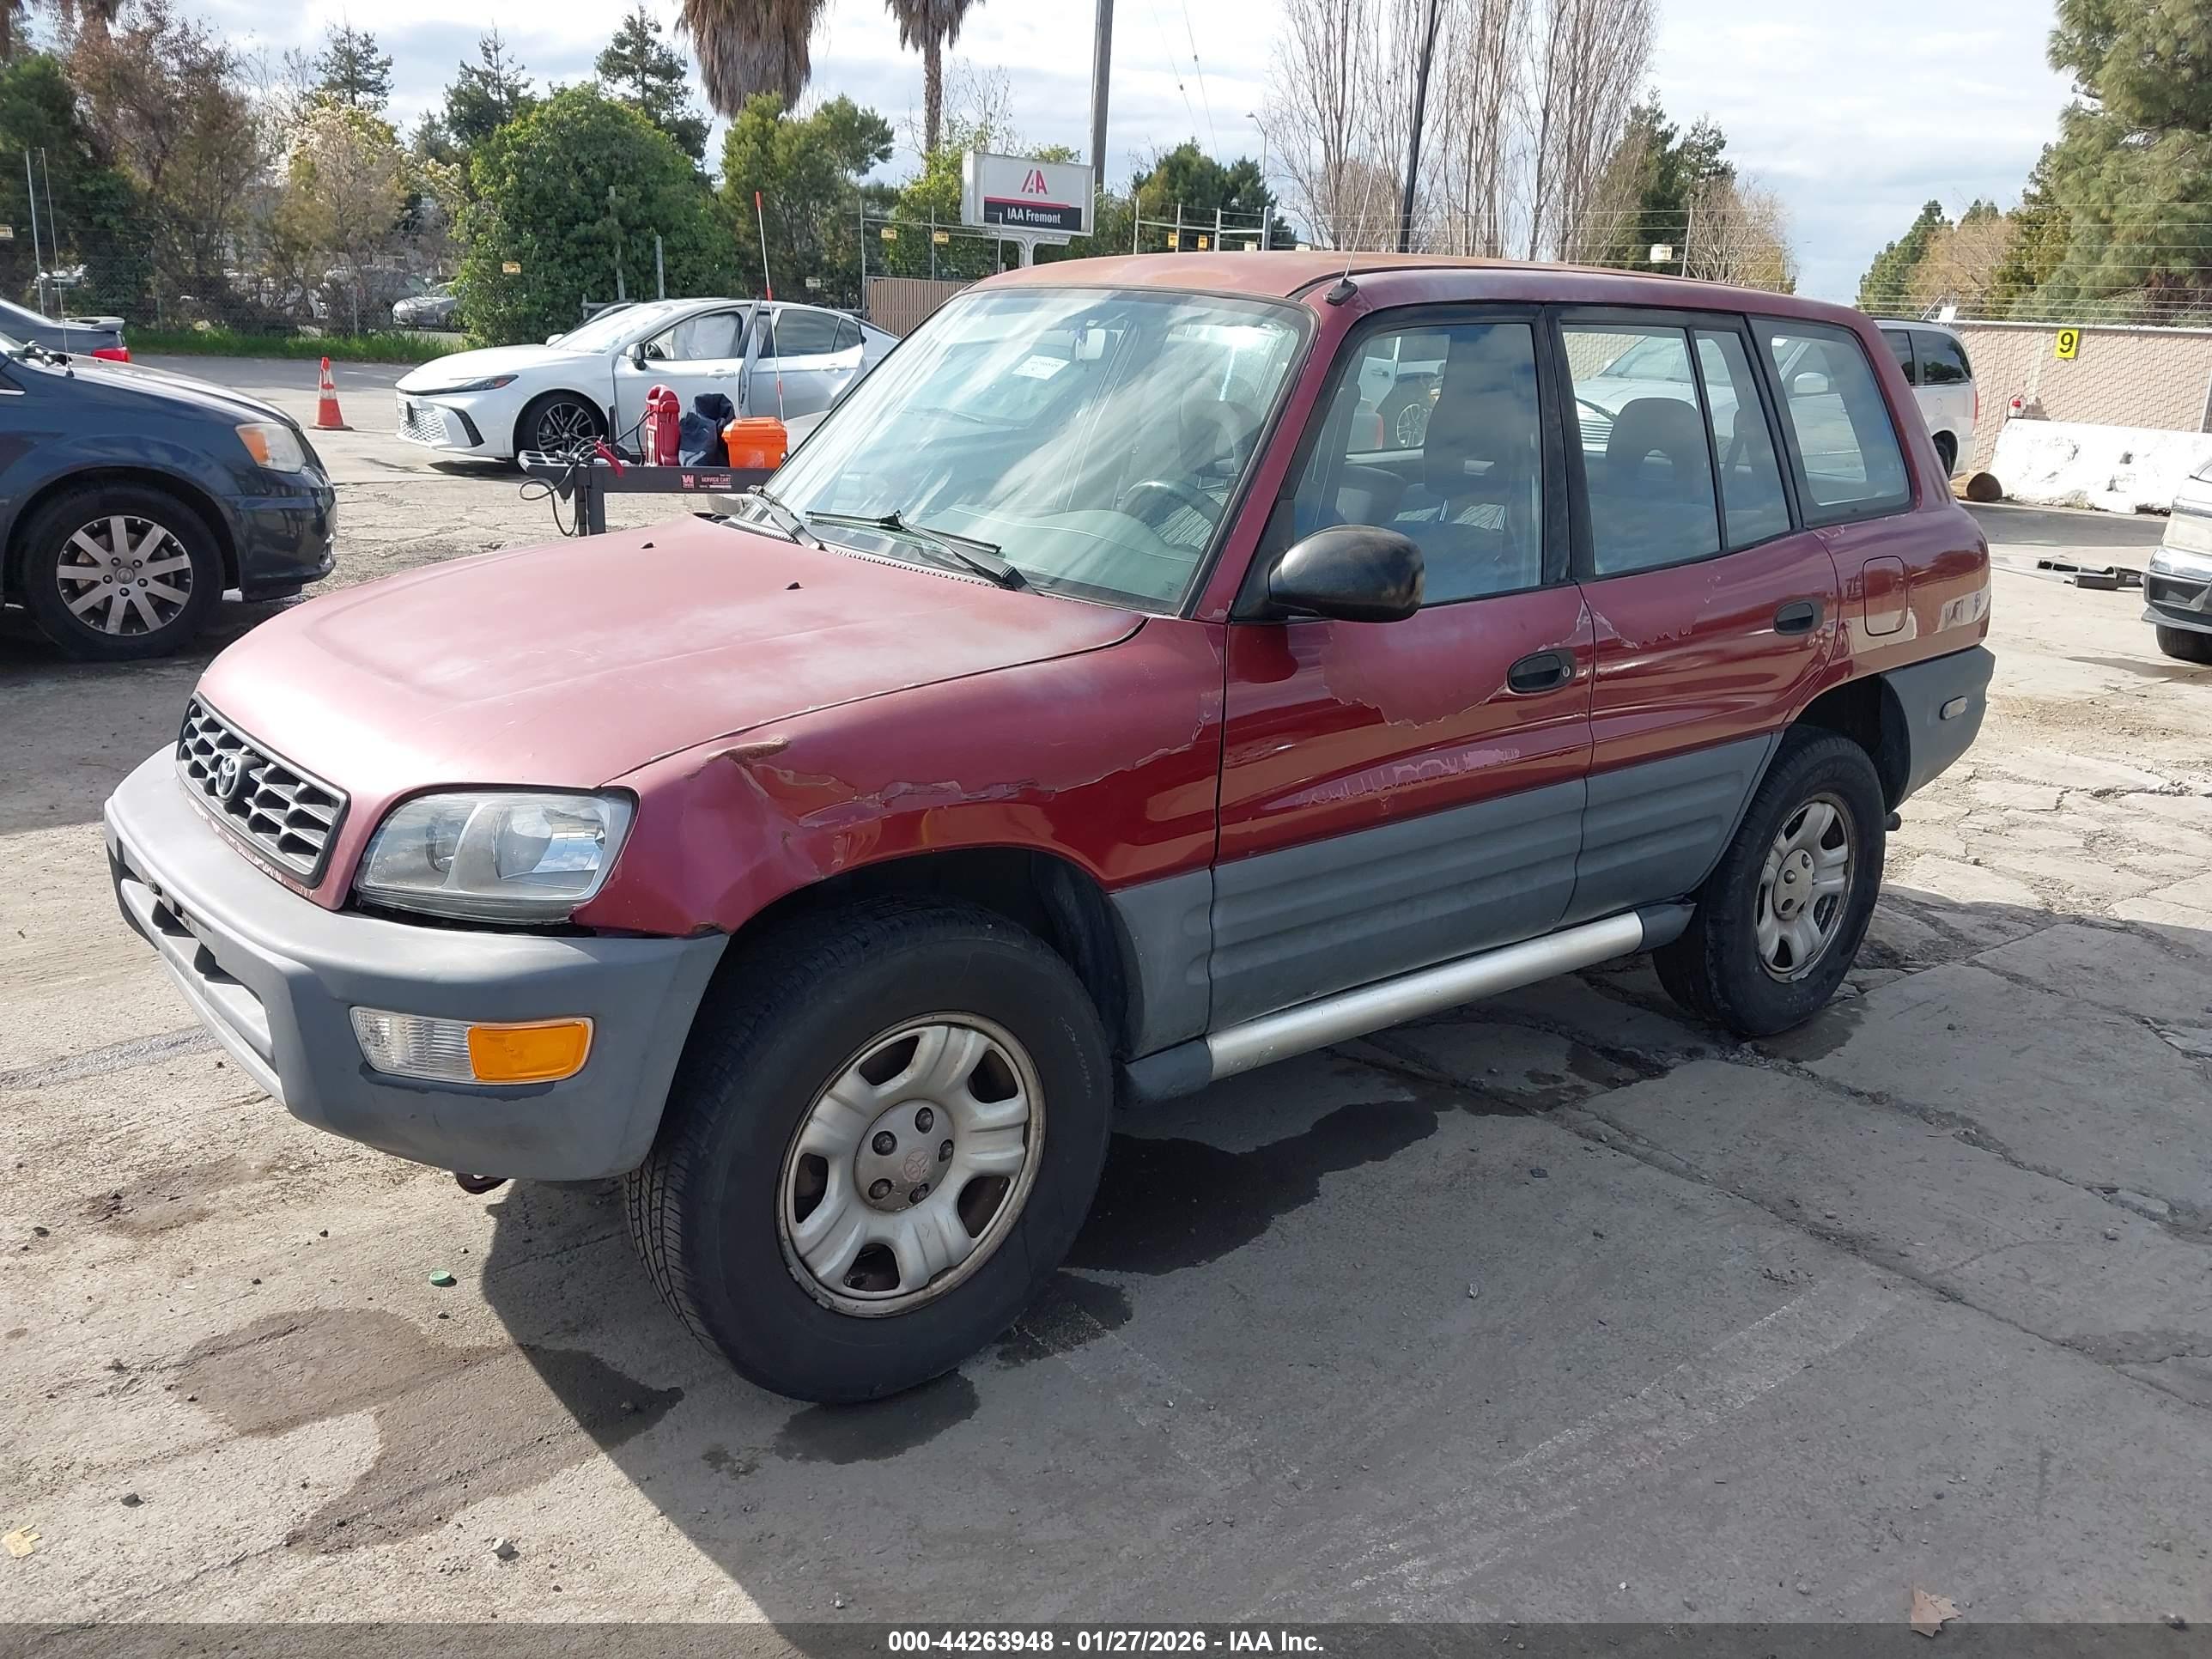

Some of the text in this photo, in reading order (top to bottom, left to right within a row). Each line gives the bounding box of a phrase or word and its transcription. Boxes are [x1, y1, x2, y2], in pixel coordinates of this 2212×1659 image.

[1007, 207, 1060, 224] IAA Fremont
[2059, 331, 2074, 353] 9
